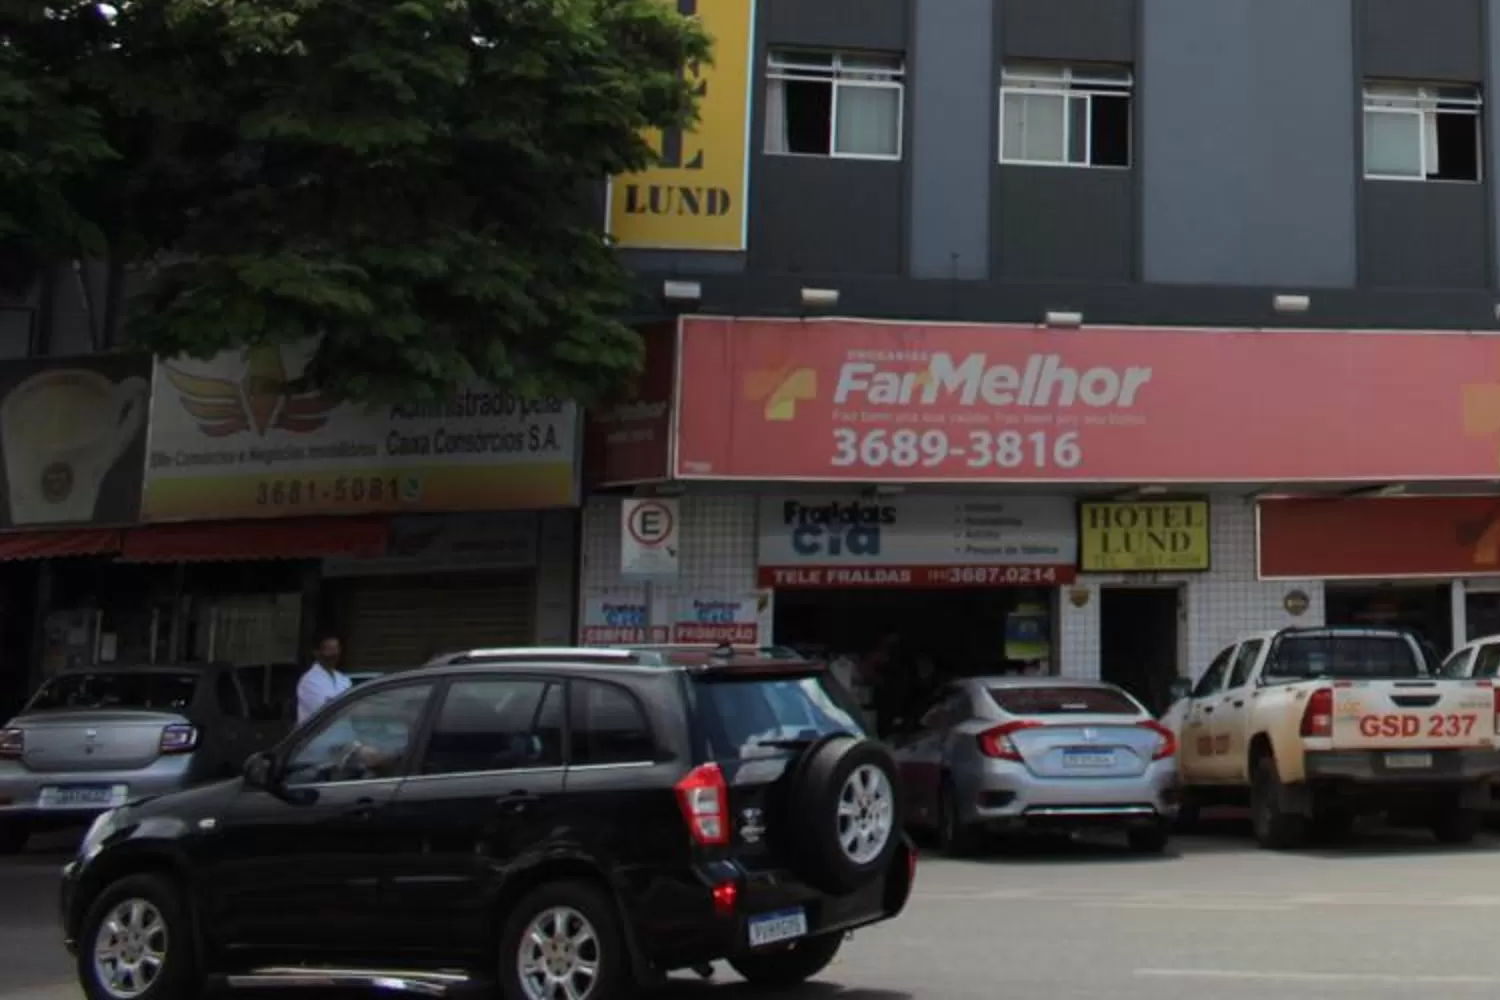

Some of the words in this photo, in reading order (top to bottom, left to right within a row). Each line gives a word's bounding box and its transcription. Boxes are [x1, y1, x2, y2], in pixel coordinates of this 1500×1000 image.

[624, 184, 731, 217] LUND
[833, 352, 1153, 407] FarMelhor
[831, 427, 1082, 468] 3689-3816
[641, 510, 661, 536] E
[1089, 504, 1204, 529] HOTEL
[1101, 530, 1192, 553] LUND
[1359, 713, 1421, 738] GSD
[1427, 712, 1478, 738] 237
